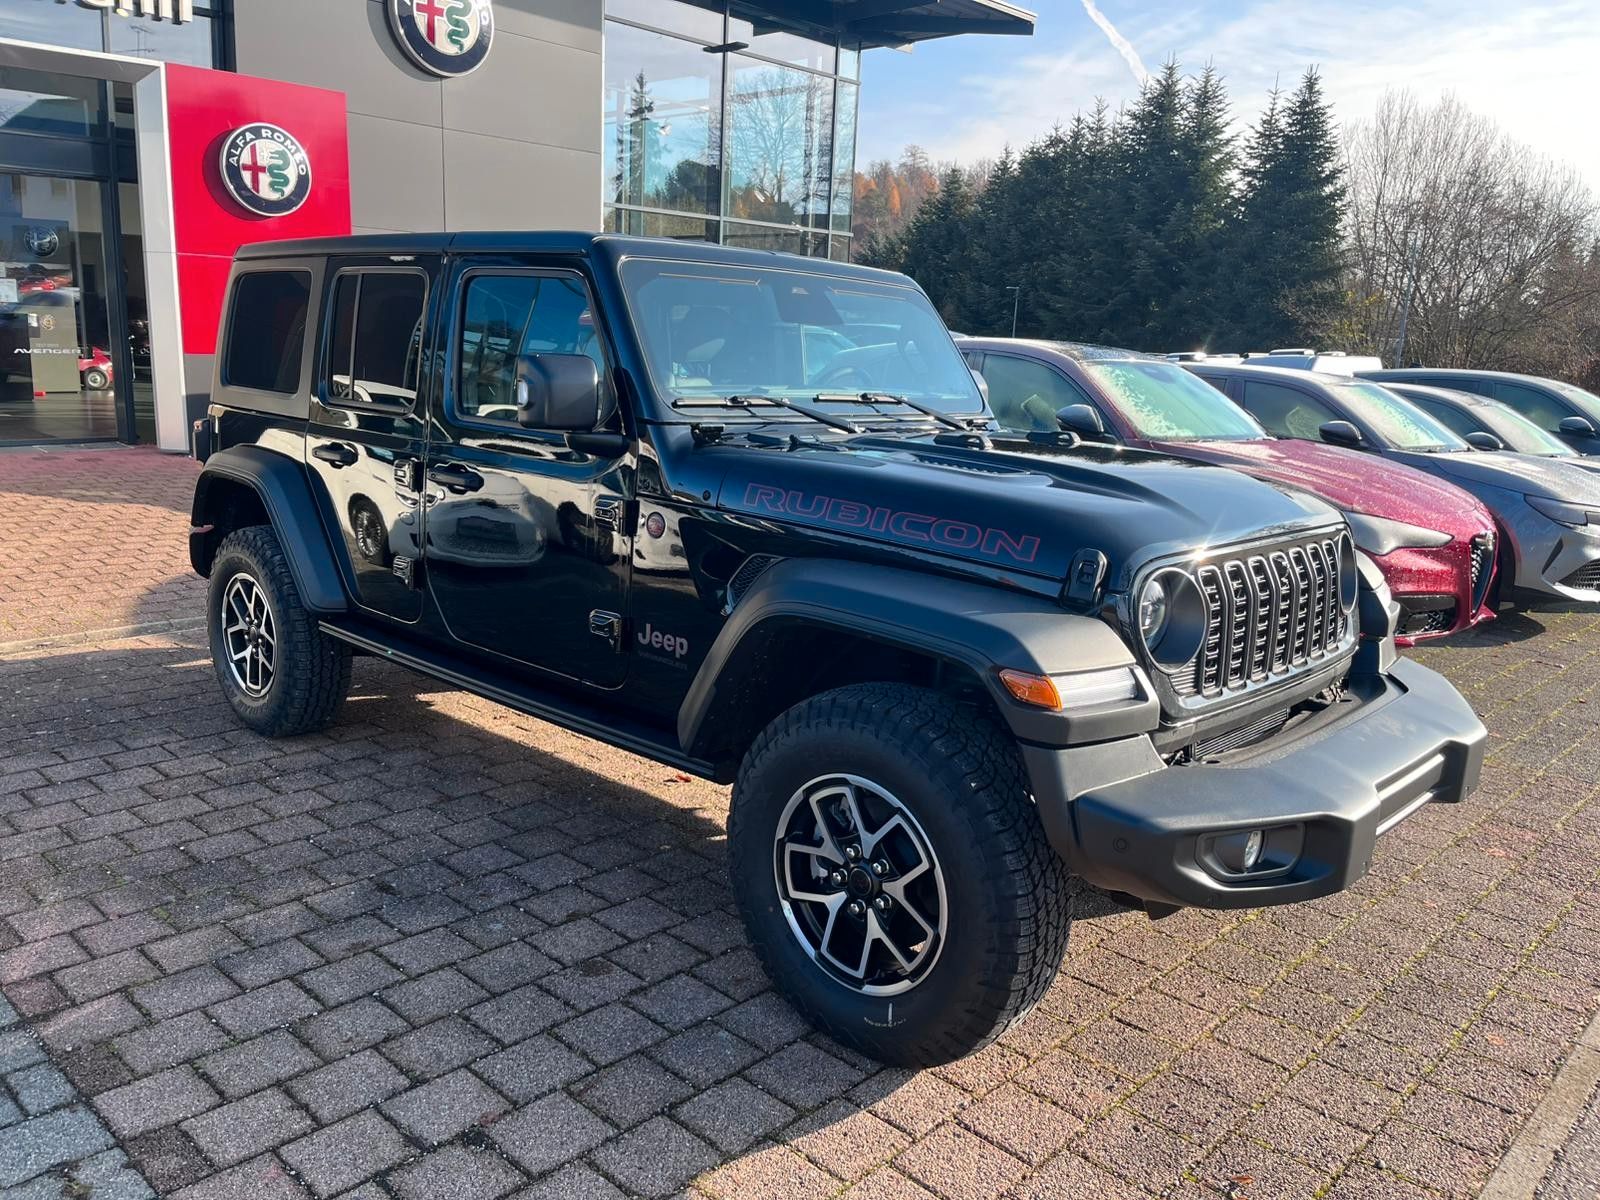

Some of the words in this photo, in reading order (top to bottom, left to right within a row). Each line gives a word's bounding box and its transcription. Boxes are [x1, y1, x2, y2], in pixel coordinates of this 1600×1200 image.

[229, 131, 256, 167] ALFA
[261, 128, 307, 175] ROMEO
[743, 482, 1040, 563] RUBICON
[637, 623, 689, 658] Jeep
